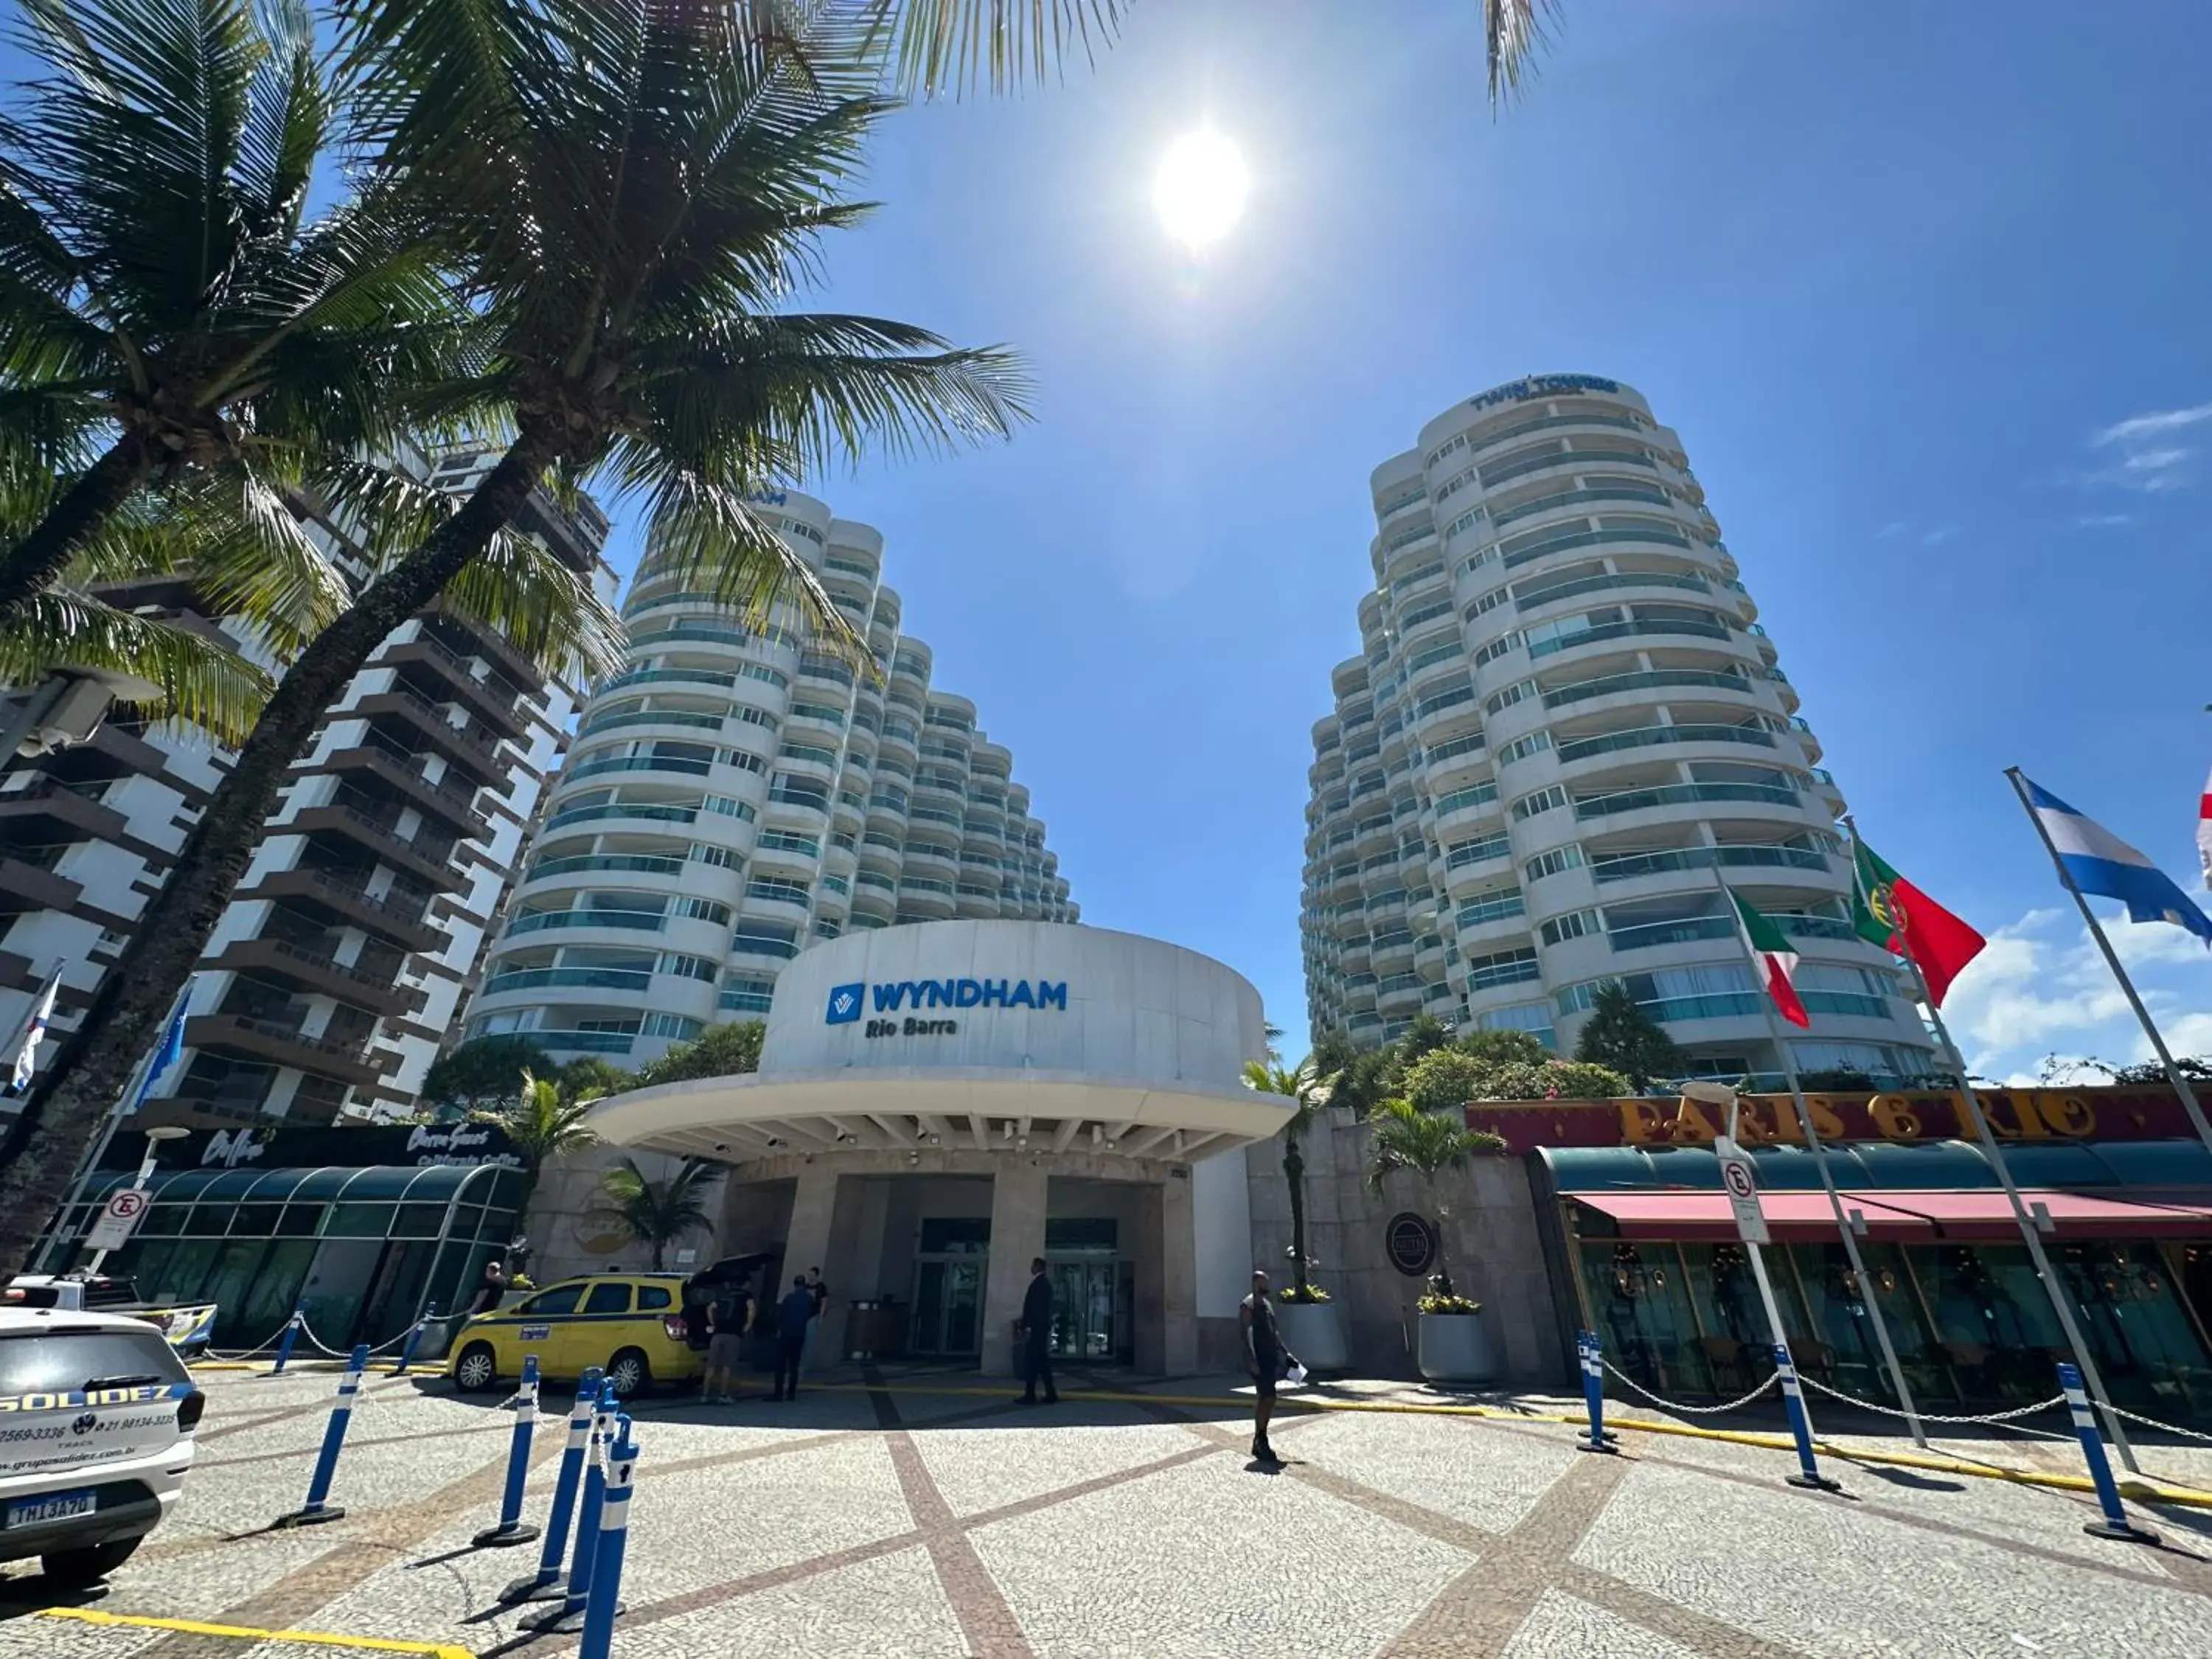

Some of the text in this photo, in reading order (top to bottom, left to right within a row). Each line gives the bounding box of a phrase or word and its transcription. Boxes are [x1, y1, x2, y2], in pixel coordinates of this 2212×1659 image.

[873, 979, 1067, 1011] WYNDHAM
[865, 1017, 957, 1038] Rio Barra
[1616, 1091, 2096, 1142] PARIS 6 RIO
